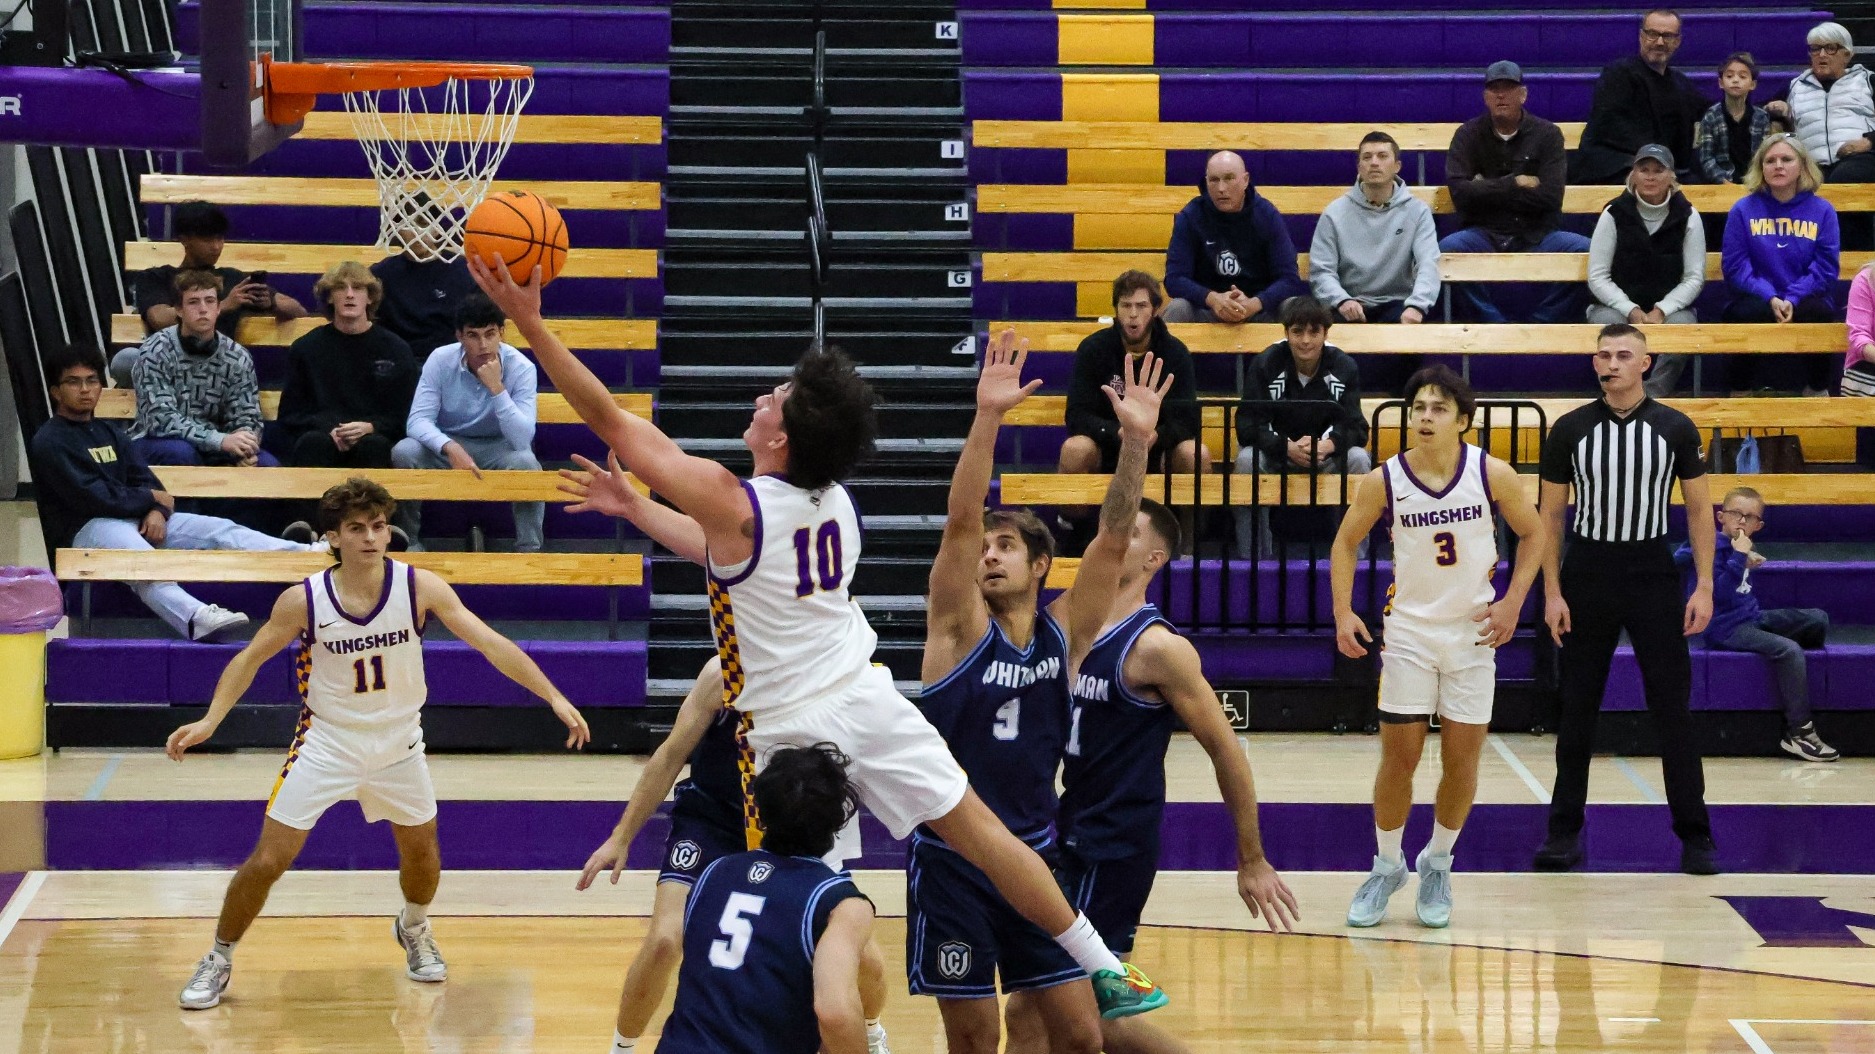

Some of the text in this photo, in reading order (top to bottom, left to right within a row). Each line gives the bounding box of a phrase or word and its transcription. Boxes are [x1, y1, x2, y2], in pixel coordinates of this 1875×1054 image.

[941, 25, 952, 36] K
[0, 96, 21, 115] R
[951, 206, 962, 218] H
[1750, 218, 1818, 241] WHITMAN
[953, 273, 965, 284] G
[1400, 505, 1482, 528] KINGSMEN
[793, 518, 844, 599] 10
[1433, 531, 1458, 567] 3
[323, 629, 409, 655] KINGSMEN
[352, 655, 386, 694] 11
[708, 891, 767, 971] 5
